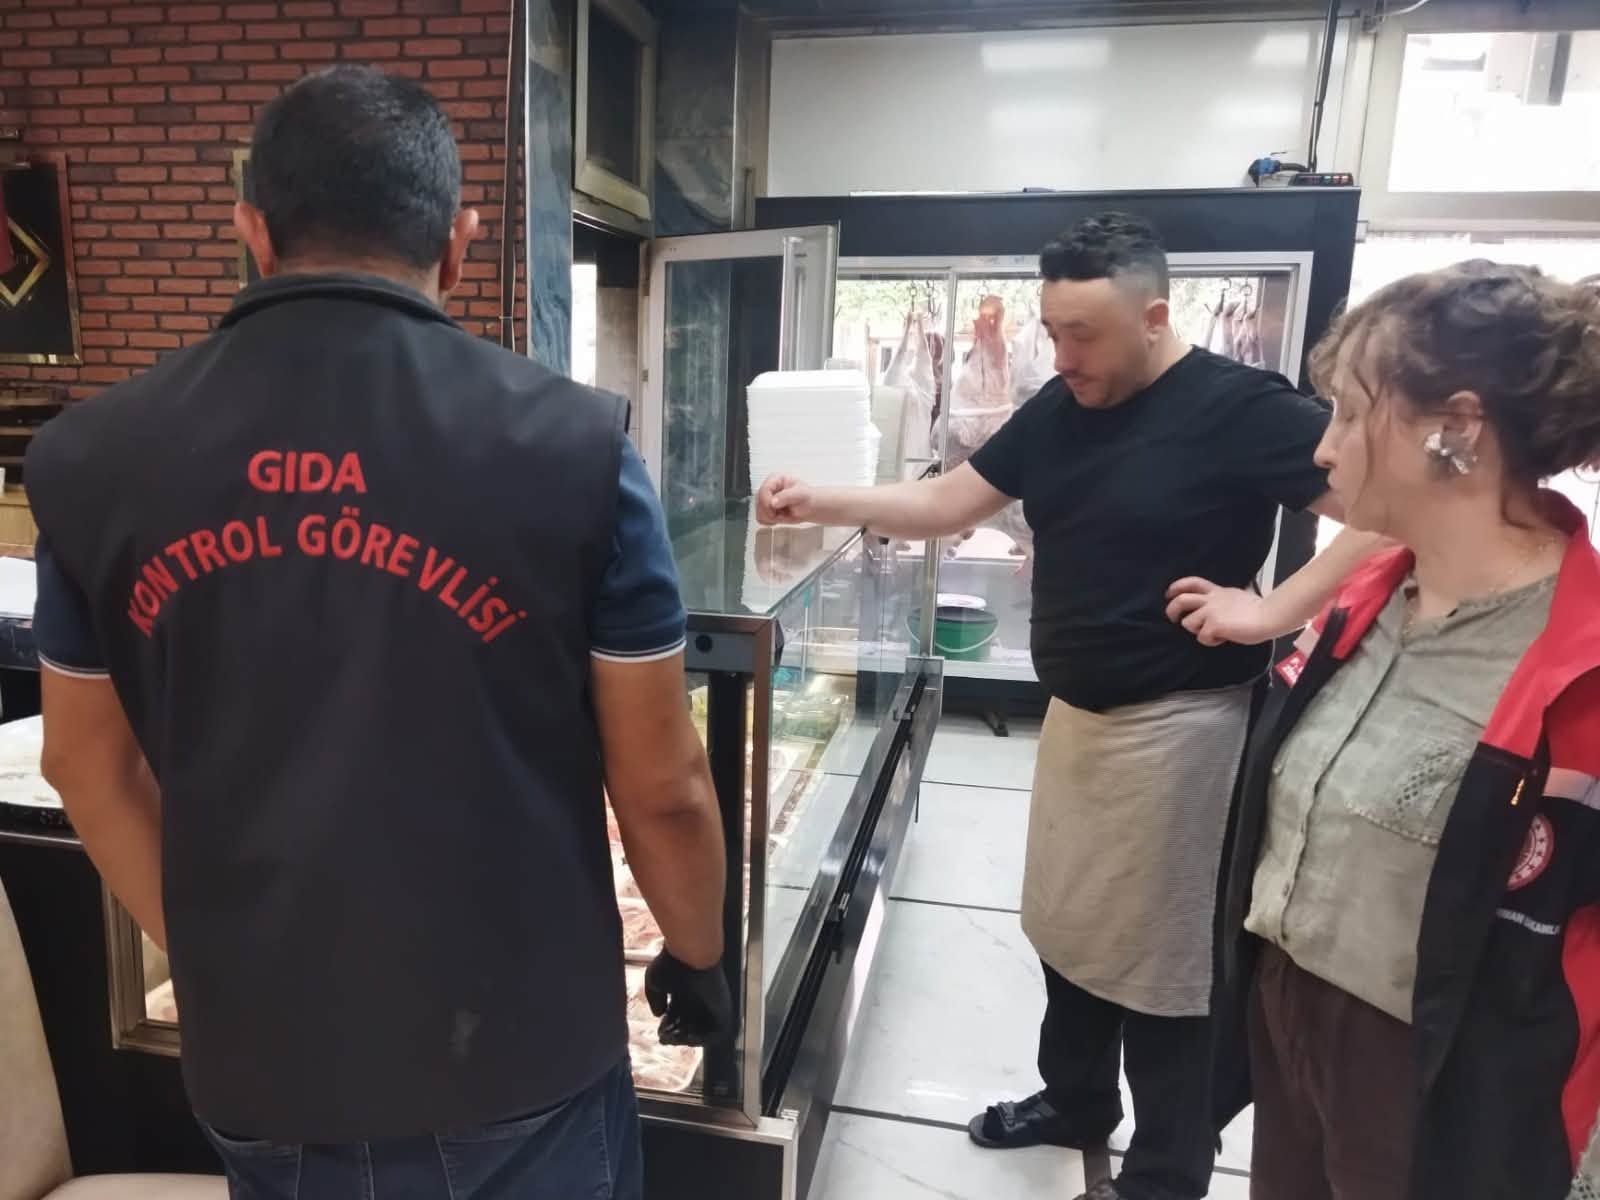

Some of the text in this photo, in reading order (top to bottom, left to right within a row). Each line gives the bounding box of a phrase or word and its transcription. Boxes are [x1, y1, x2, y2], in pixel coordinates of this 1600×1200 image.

[247, 450, 368, 494] GIDA
[128, 506, 527, 643] KONTROL GÖREVLİSİ
